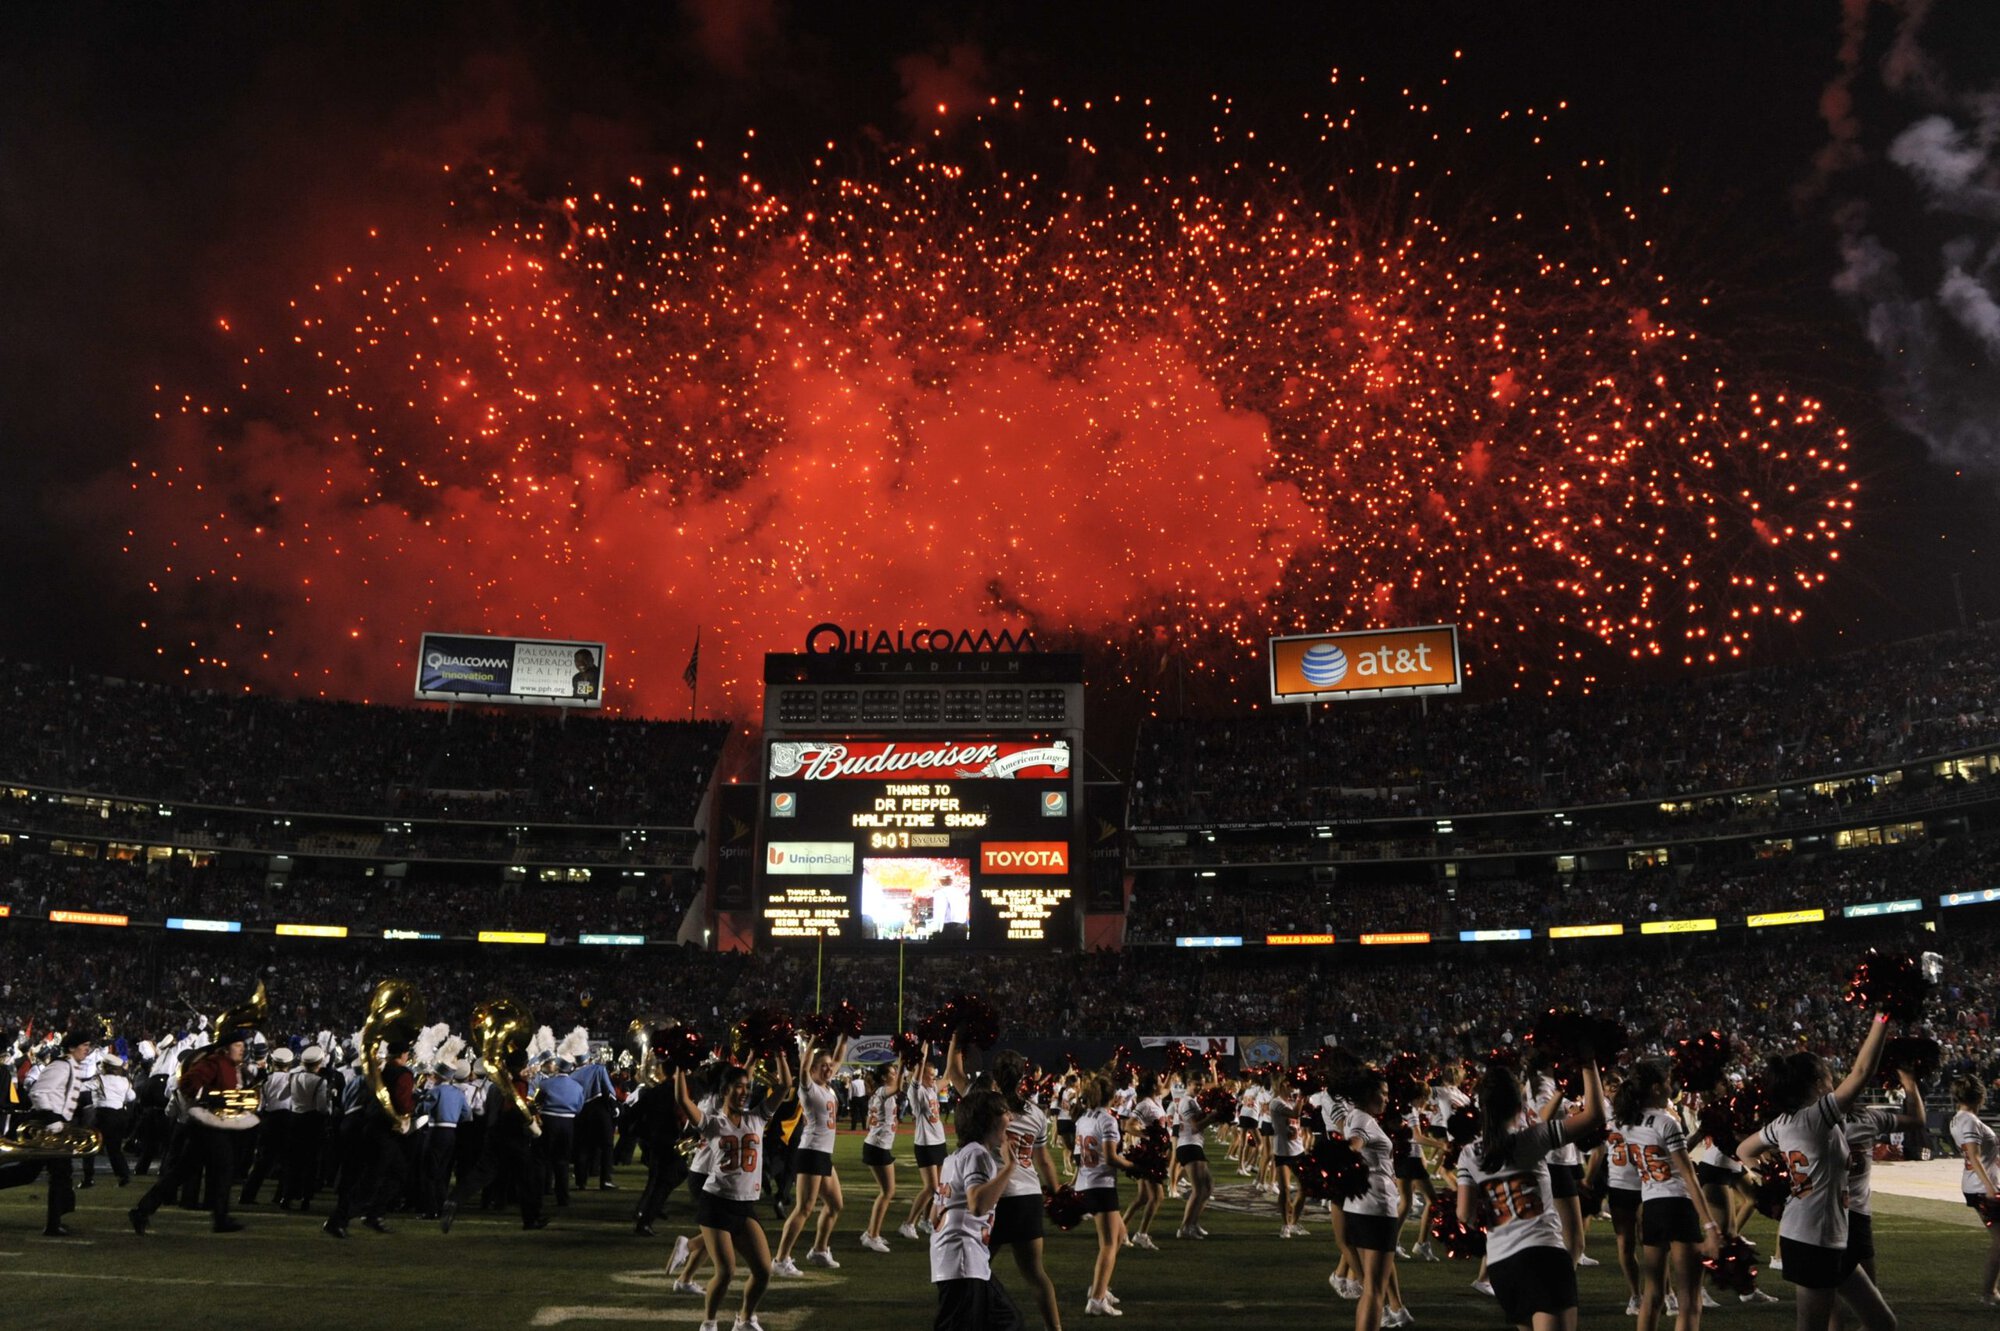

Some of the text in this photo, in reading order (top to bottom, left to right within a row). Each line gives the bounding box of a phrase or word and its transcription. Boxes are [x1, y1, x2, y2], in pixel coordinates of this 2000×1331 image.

[806, 622, 1037, 654] QUALCOMM
[519, 647, 573, 658] PALOMAR
[1357, 643, 1433, 675] at&t
[427, 653, 508, 670] QUALCOMM
[518, 657, 572, 667] POMERADO
[854, 661, 1019, 672] STADIUM
[517, 667, 572, 676] HEALTH
[800, 741, 997, 781] Budweiser
[1000, 753, 1067, 772] American Lager
[886, 785, 950, 796] THANKS TO
[874, 799, 960, 812] DR PEPPER
[852, 814, 987, 827] HALFTIME SHOW
[912, 836, 949, 844] SYCUAN
[720, 846, 752, 859] Sprint
[789, 854, 852, 864] UnionBank
[985, 851, 1064, 866] TOYOTA
[1007, 929, 1044, 939] MILLER
[1269, 935, 1333, 944] WELLS FARGO
[856, 1041, 883, 1053] PACIFIC
[1207, 1038, 1228, 1053] N
[718, 1133, 760, 1173] 36
